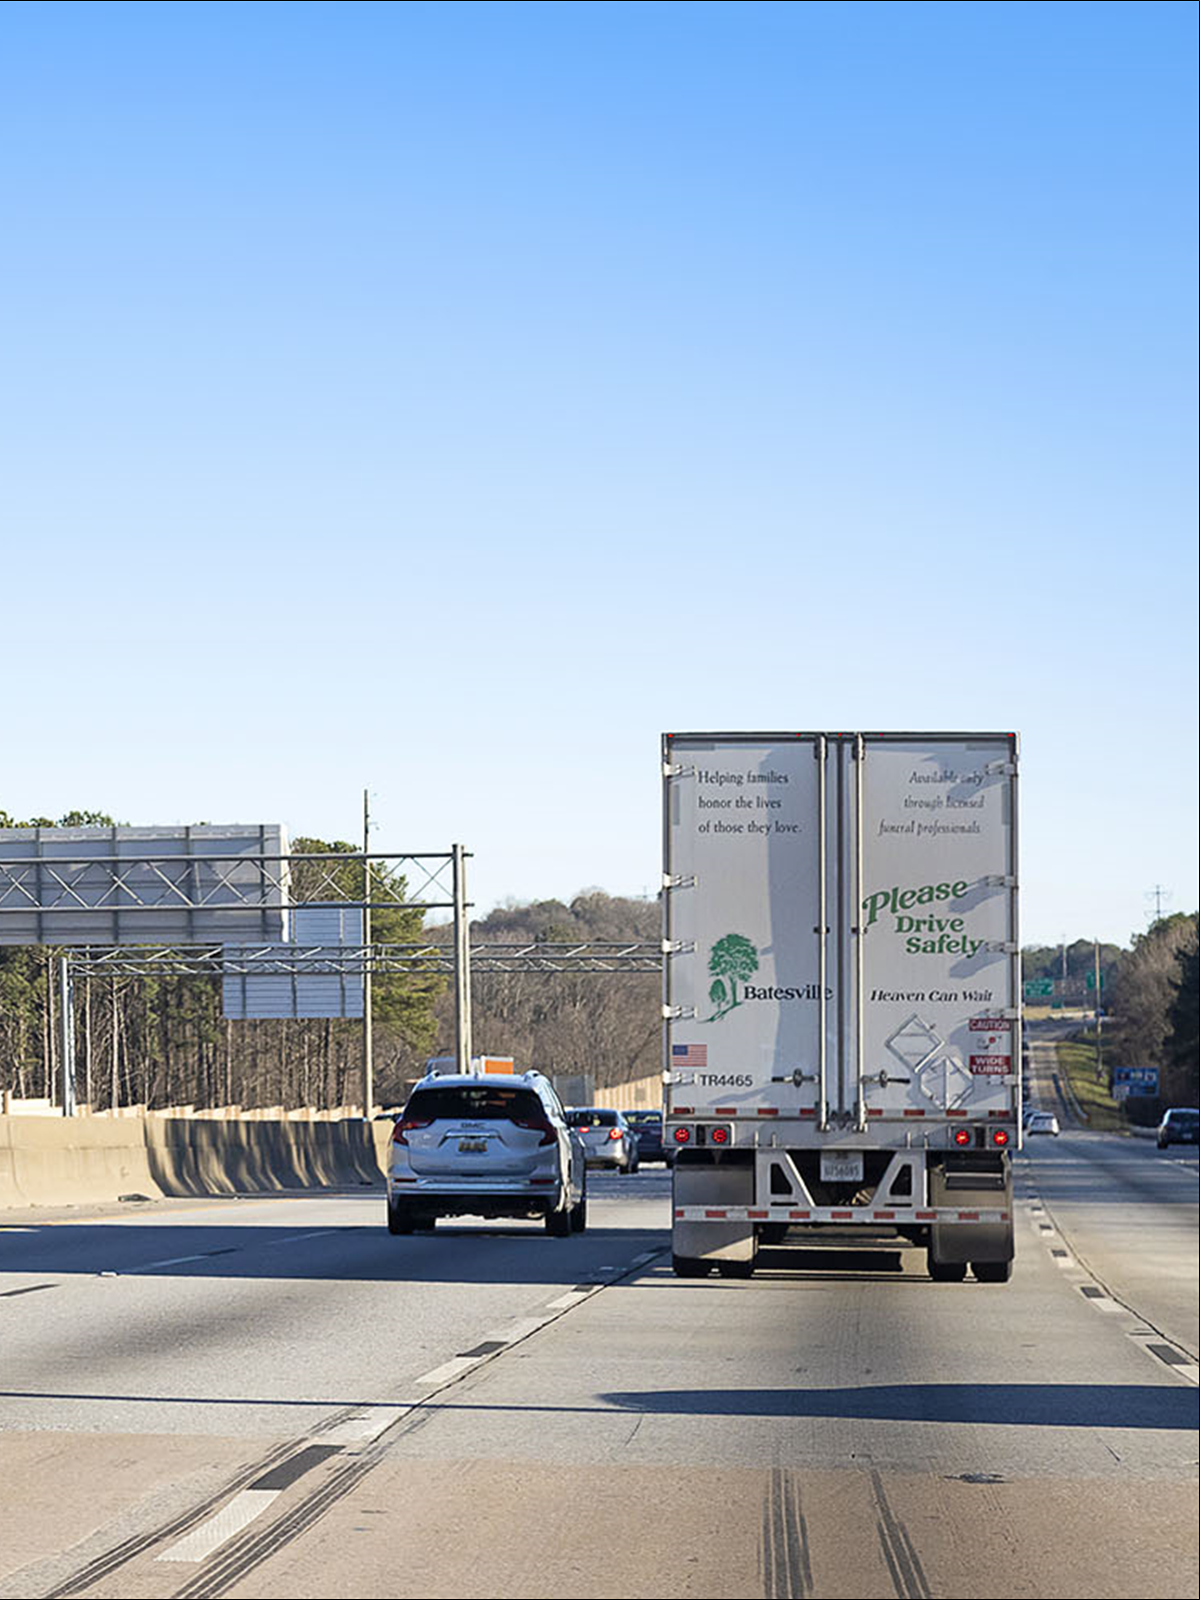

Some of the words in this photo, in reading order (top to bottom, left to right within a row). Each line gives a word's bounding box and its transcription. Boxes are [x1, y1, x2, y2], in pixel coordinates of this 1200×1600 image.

[698, 770, 744, 787] Helping
[747, 770, 789, 783] families
[698, 796, 732, 809] honor
[735, 796, 753, 809] the
[756, 796, 782, 809] lives
[904, 795, 944, 811] through
[946, 795, 985, 808] licensed
[698, 820, 711, 833] of
[714, 820, 744, 833] those
[747, 820, 772, 836] they
[774, 820, 803, 833] love.
[878, 819, 915, 836] funeral
[916, 819, 981, 836] professionals
[862, 880, 969, 926] Please
[895, 914, 965, 933] Drive
[906, 933, 984, 959] Safely
[744, 984, 834, 1001] Batesville
[870, 989, 926, 1002] Heaven
[928, 989, 959, 1002] Can
[962, 989, 993, 1002] Wait
[970, 1019, 1010, 1030] CAUTION
[974, 1056, 1006, 1065] WIDE
[971, 1065, 1009, 1074] TURNS
[700, 1074, 753, 1087] TR4465
